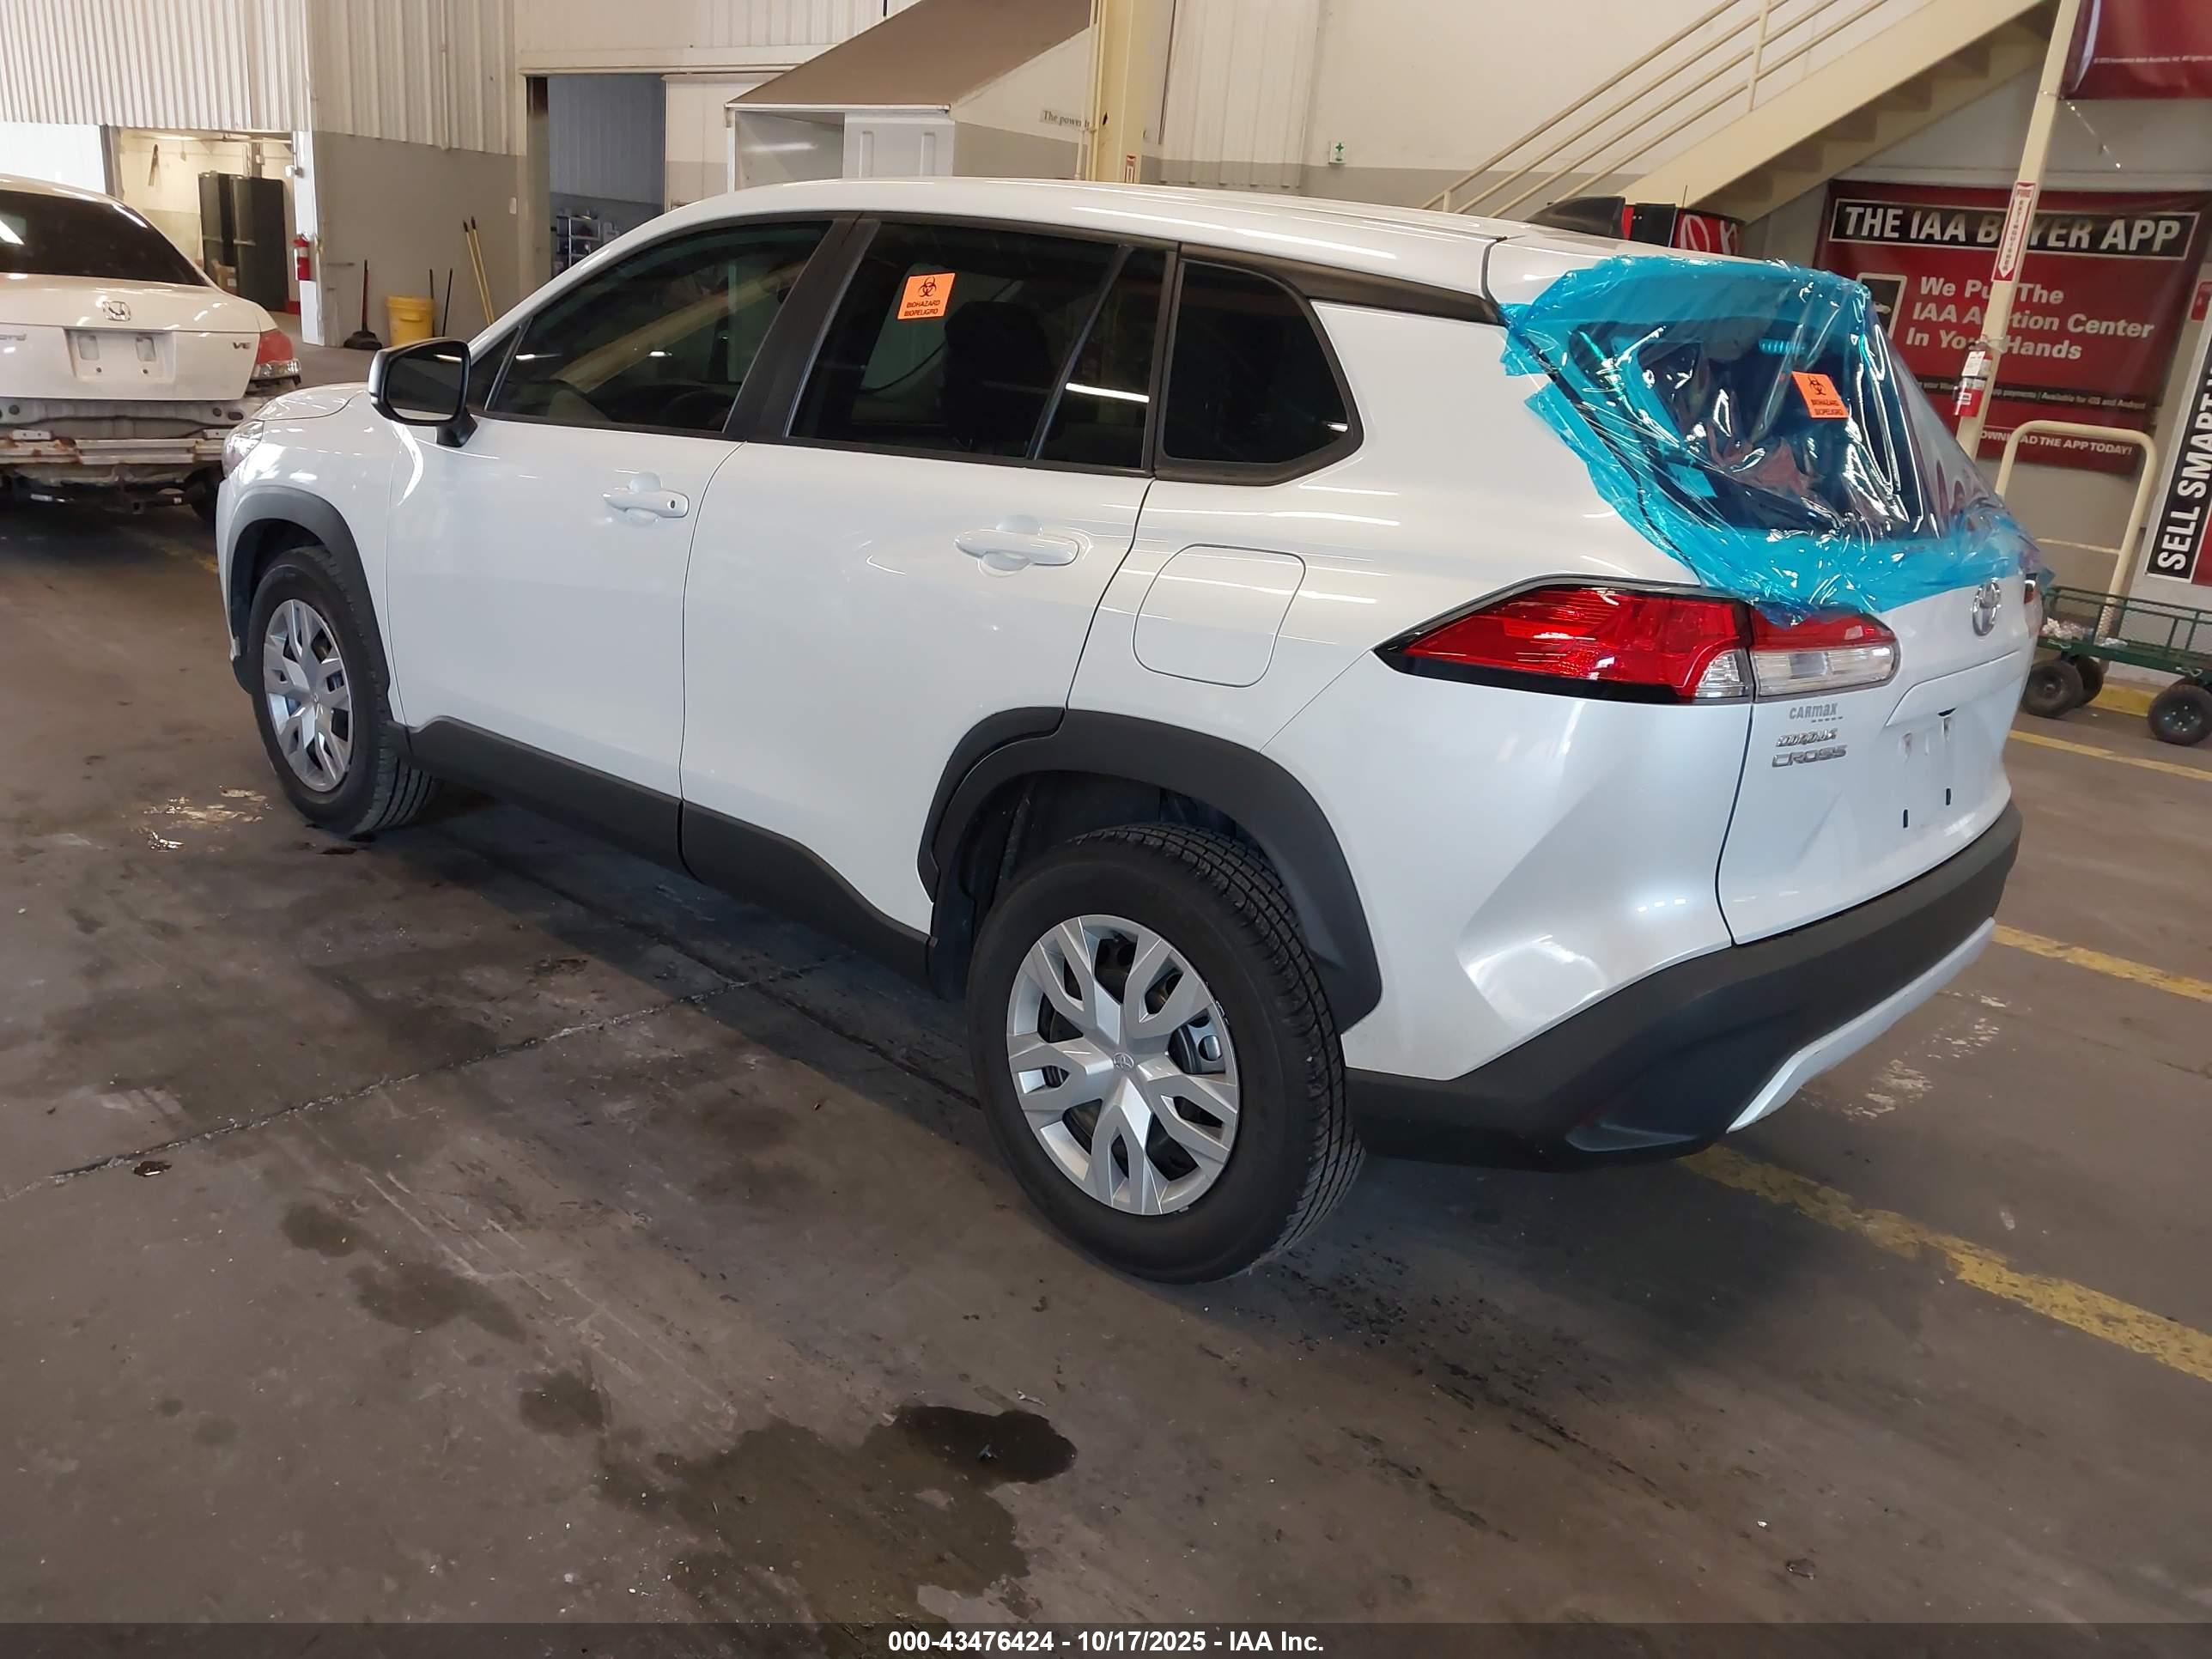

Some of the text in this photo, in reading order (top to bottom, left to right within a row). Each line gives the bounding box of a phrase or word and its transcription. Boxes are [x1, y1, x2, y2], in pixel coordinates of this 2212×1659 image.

[1845, 206, 2181, 252] THE IAA BYER APP
[906, 300, 941, 308] BIOHAZARD
[1920, 276, 2064, 304] We Pu The
[1911, 301, 2155, 338] IAA Ation Center
[1905, 327, 2082, 360] In Yo Hands
[2039, 435, 2062, 447] THE
[2063, 439, 2090, 450] APP
[2090, 441, 2134, 455] TODAY!
[2156, 505, 2202, 570] SELL
[1771, 744, 1848, 768] CROSS
